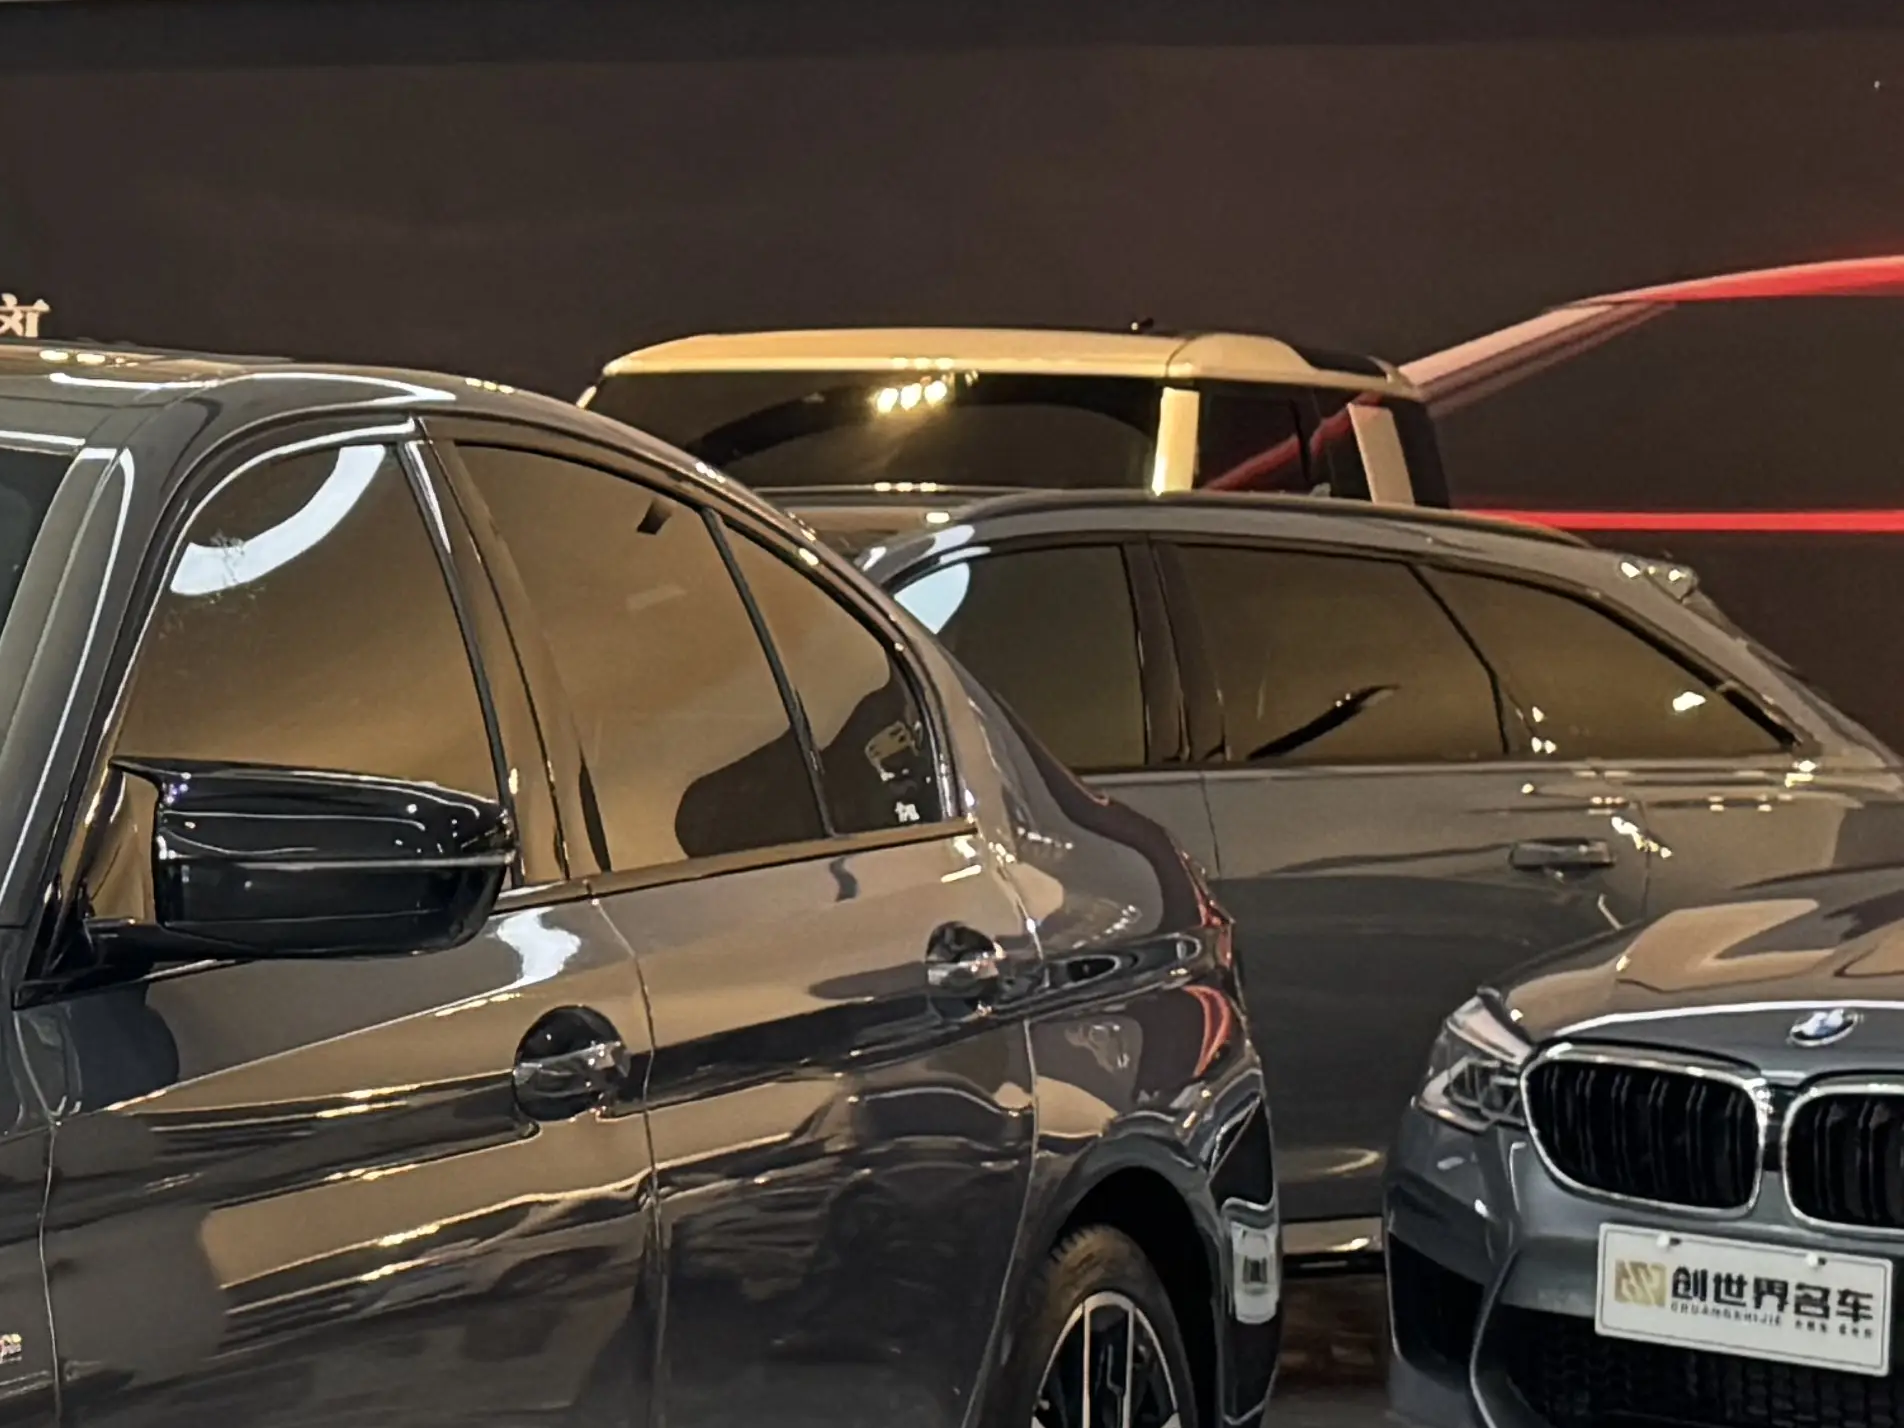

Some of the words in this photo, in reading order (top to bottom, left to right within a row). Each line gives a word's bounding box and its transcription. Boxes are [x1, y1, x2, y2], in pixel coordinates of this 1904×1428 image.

[1671, 1265, 1874, 1323] 创世界名车
